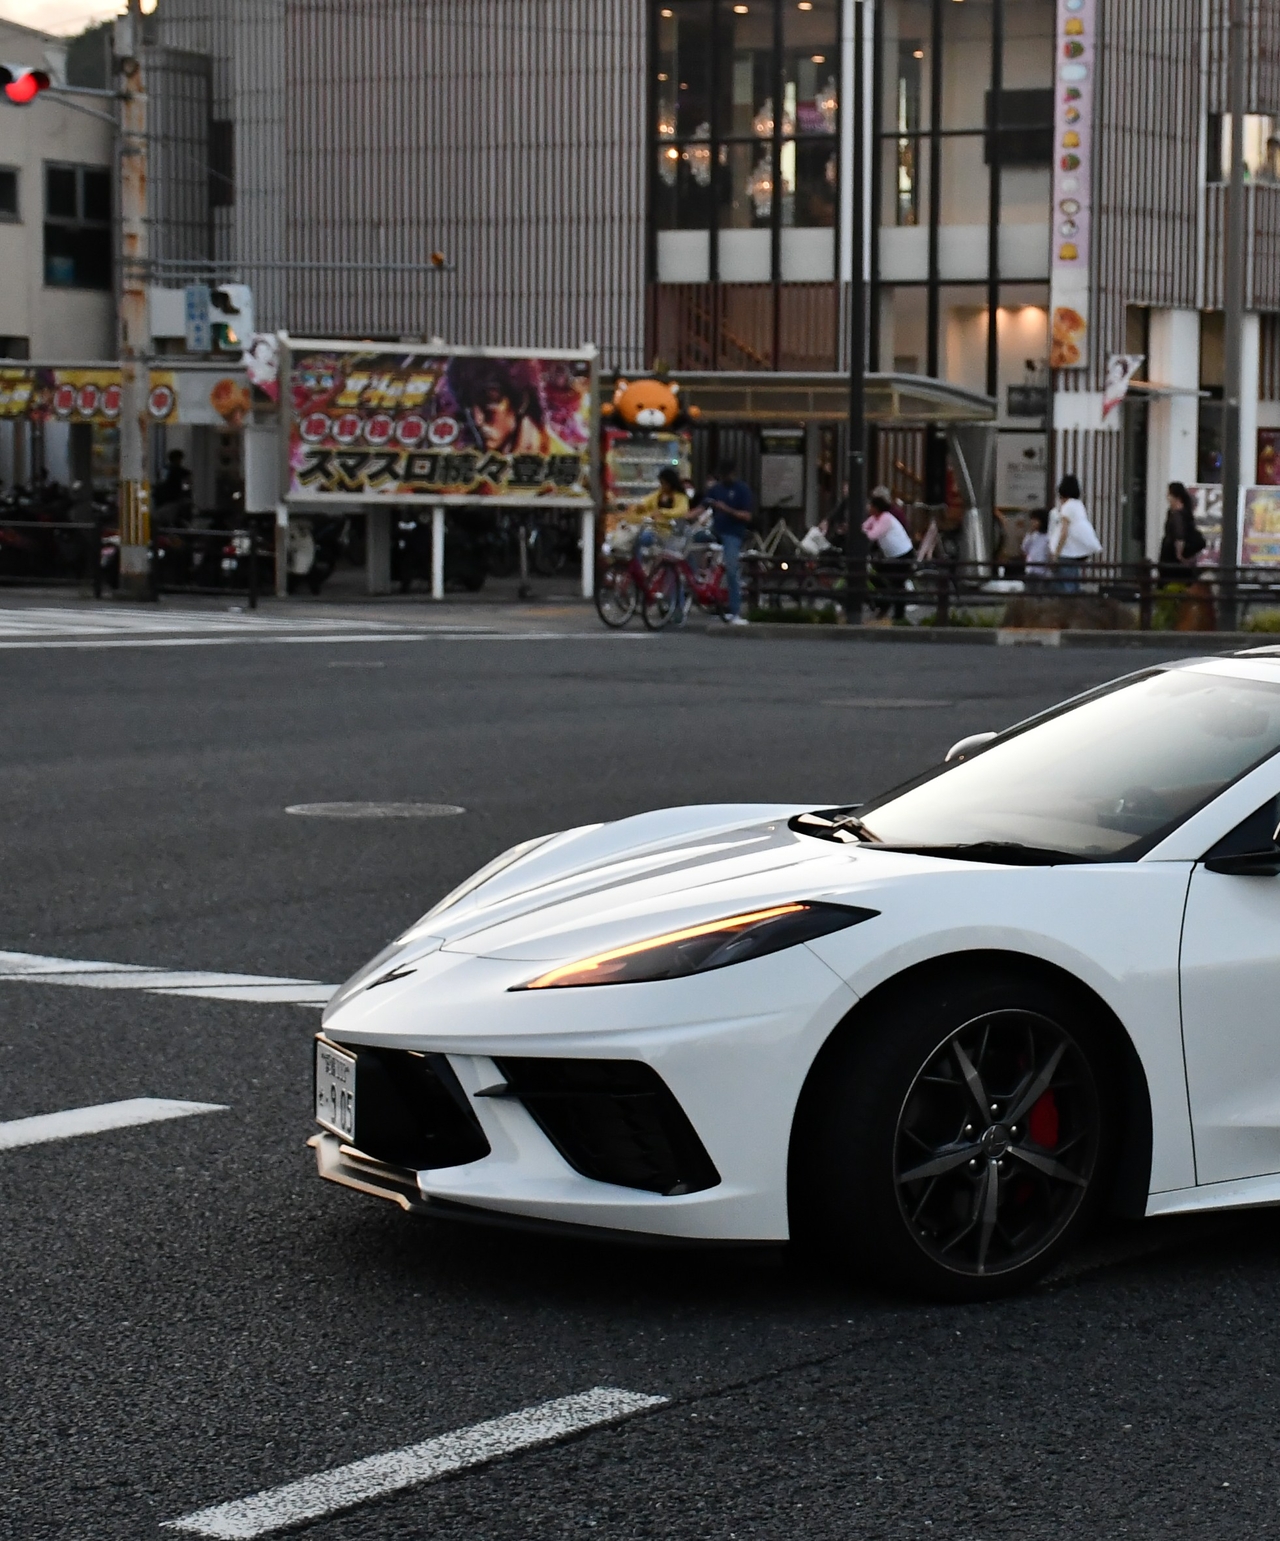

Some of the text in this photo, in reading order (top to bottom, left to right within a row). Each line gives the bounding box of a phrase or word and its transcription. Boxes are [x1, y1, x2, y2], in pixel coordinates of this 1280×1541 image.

[298, 450, 582, 487] スマスロ続々登場
